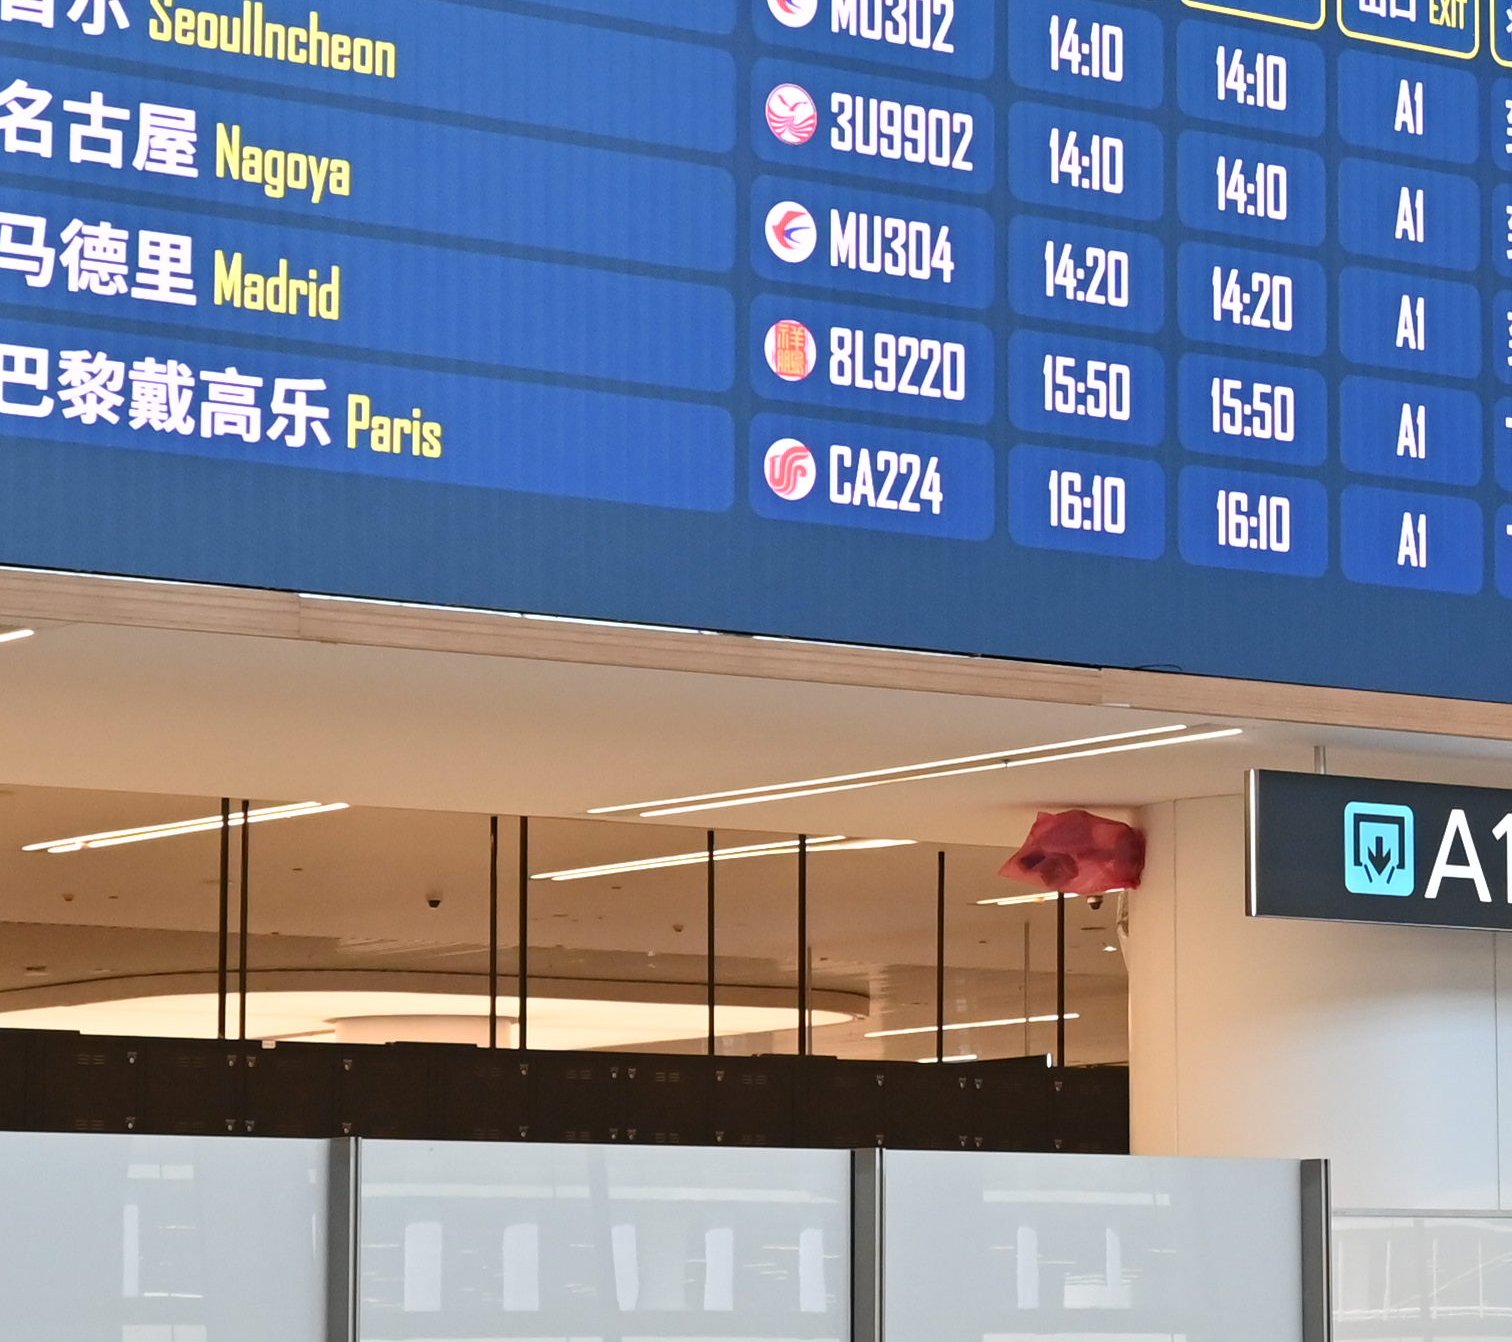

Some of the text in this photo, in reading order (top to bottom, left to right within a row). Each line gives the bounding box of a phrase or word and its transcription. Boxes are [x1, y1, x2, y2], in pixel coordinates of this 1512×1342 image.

[1049, 14, 1124, 82] 14:10
[1216, 45, 1287, 111] 14:10
[830, 92, 974, 172] 3U9902
[1394, 79, 1424, 136] A1
[215, 122, 351, 204] Nagoya
[1049, 127, 1124, 194] 14:10
[1216, 155, 1287, 221] 14:10
[830, 208, 955, 284] MU304
[1395, 186, 1425, 243] A1
[213, 249, 340, 321] Madrid
[1044, 240, 1129, 308] 14:20
[1212, 266, 1293, 332] 14:20
[1395, 294, 1425, 351] A1
[829, 326, 966, 401] 8L9220
[1042, 354, 1131, 421] 15:50
[347, 393, 442, 459] Paris
[1211, 377, 1295, 442] 15:50
[1396, 403, 1426, 460] A1
[829, 444, 944, 515] CA224
[1048, 469, 1126, 534] 16:10
[1216, 489, 1291, 553] 16:10
[1397, 511, 1427, 568] A1
